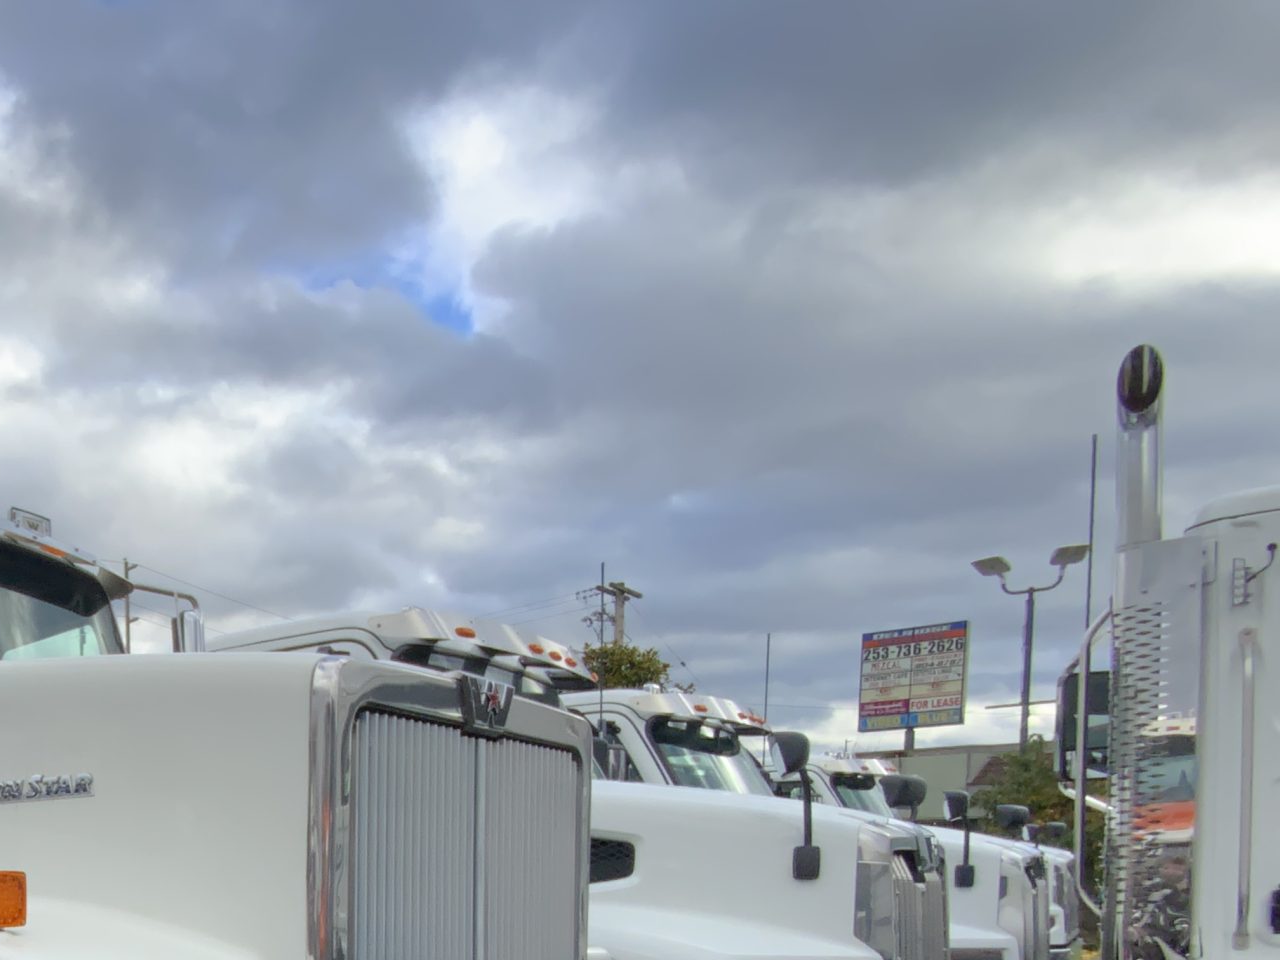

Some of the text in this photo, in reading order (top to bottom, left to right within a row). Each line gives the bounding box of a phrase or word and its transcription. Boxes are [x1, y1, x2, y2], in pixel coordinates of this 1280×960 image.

[863, 638, 964, 661] 253-736-2626
[911, 699, 929, 710] FOR
[931, 697, 961, 709] LEASE
[26, 773, 93, 799] STAR
